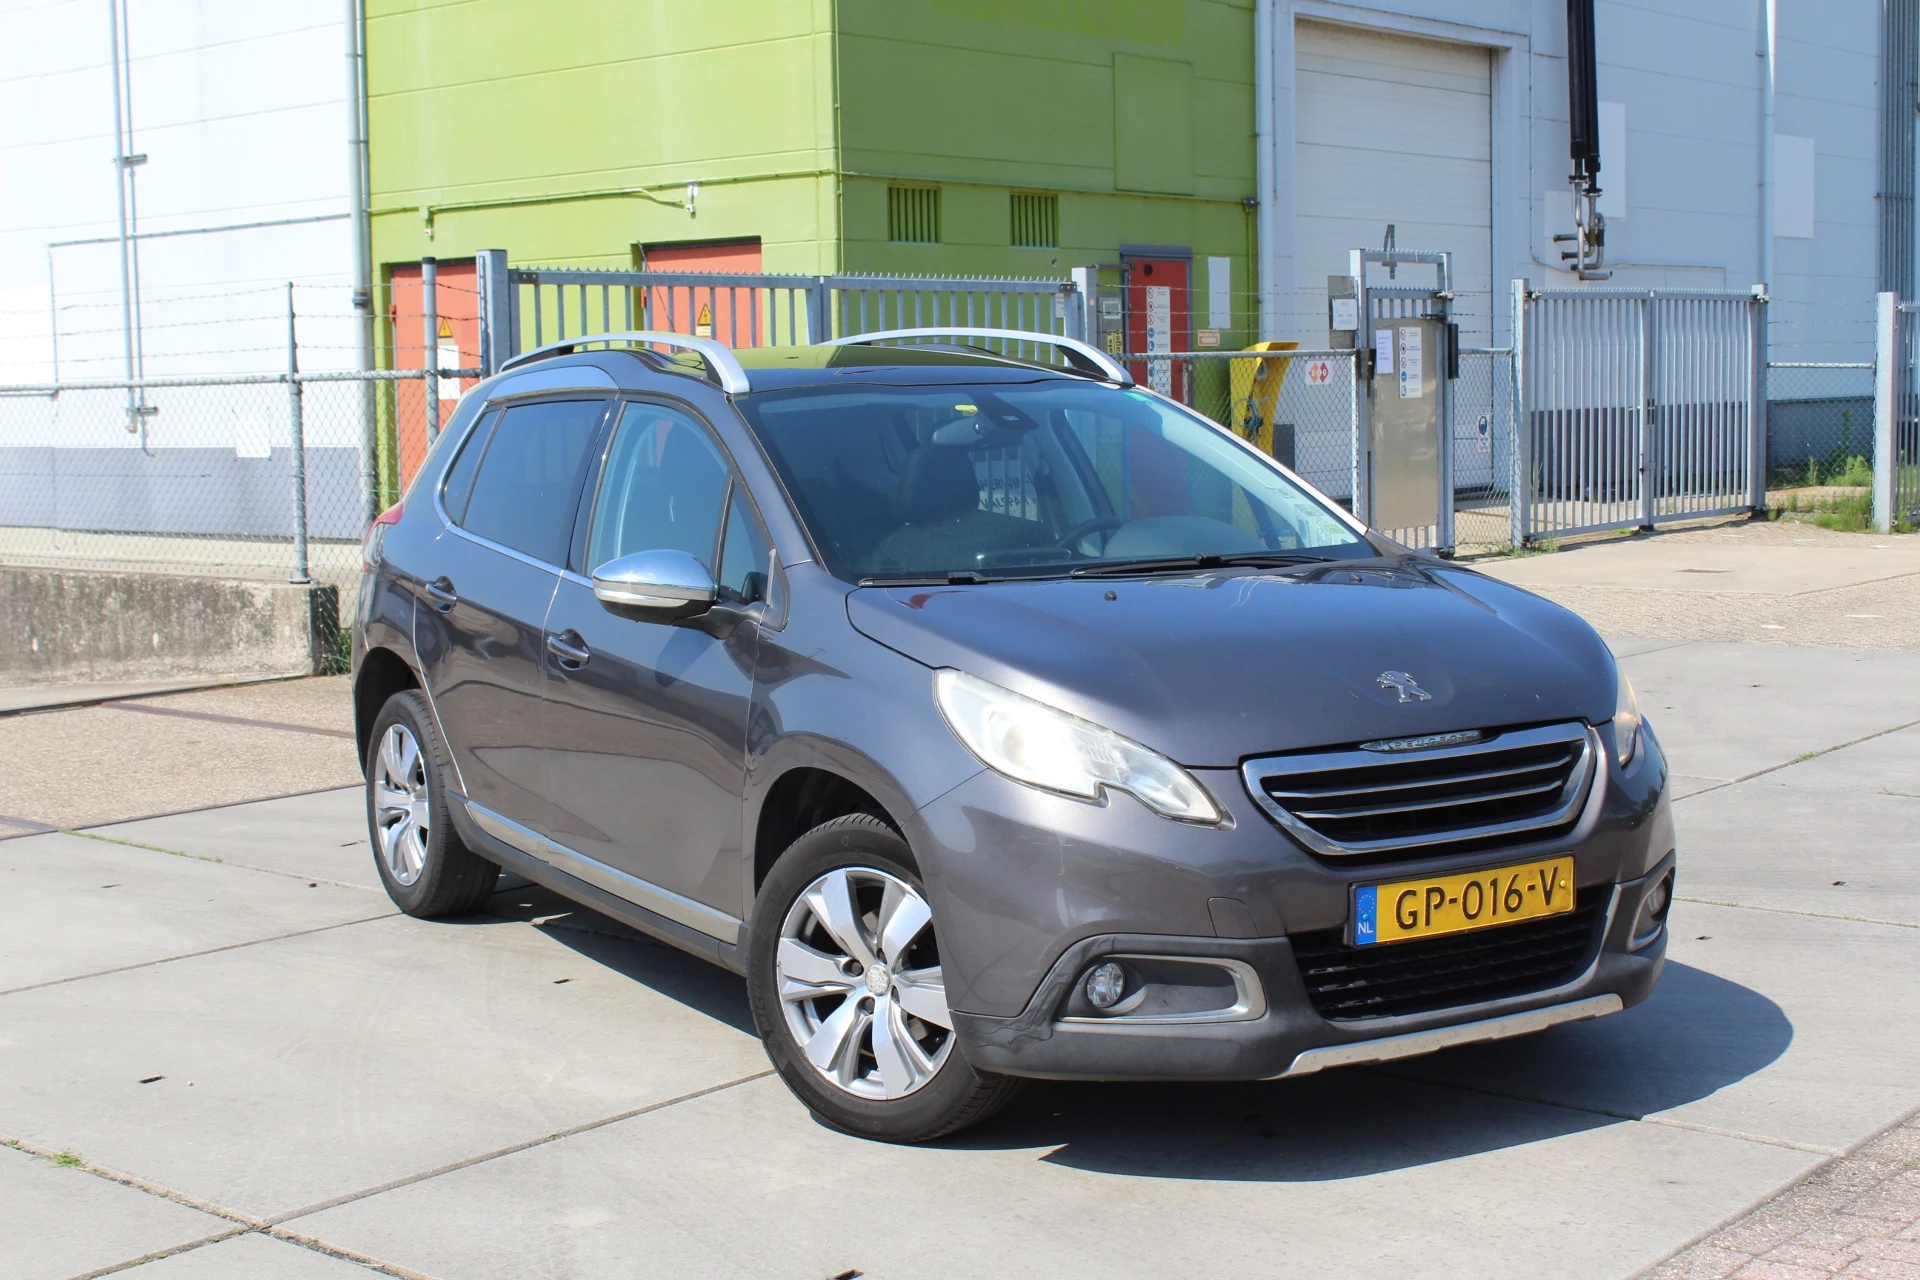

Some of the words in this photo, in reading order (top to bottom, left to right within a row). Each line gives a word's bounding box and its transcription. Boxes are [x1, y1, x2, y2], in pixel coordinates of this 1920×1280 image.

[1381, 224, 1398, 279] 4
[1394, 734, 1466, 749] PEUGEOT
[1395, 867, 1559, 930] GP-016-V
[1357, 921, 1374, 935] NL
